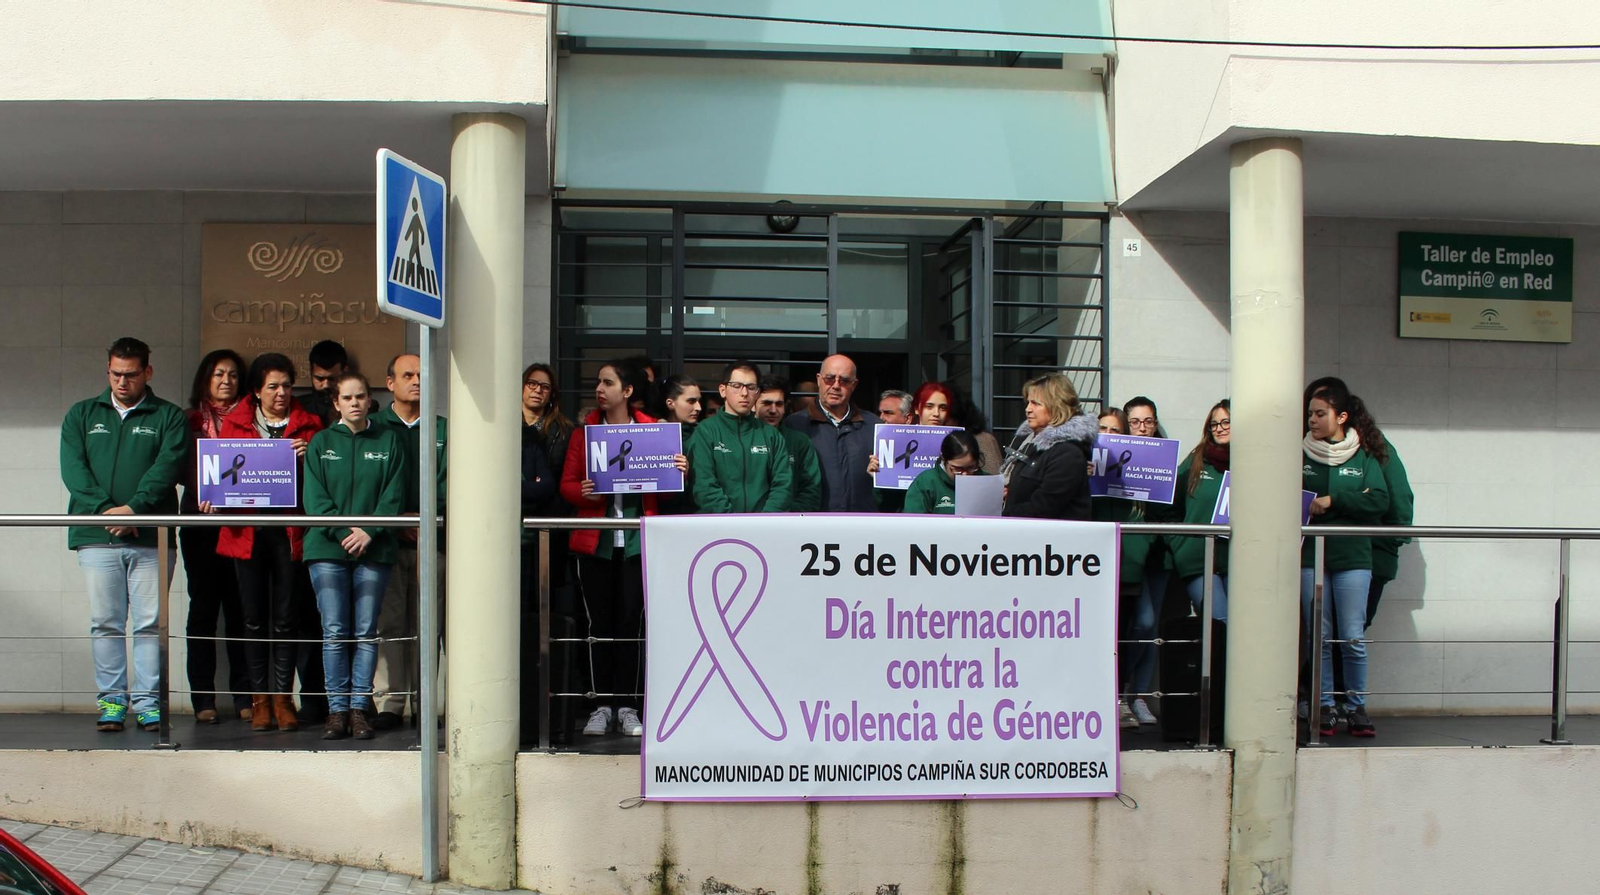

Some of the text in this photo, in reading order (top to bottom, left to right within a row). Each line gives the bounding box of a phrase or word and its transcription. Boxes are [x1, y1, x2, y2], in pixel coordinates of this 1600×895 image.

[1126, 243, 1138, 251] 45
[1421, 245, 1554, 269] Taller de Empleo
[1421, 269, 1553, 290] Campiñ@ en Red
[211, 293, 387, 332] campiñasu
[590, 441, 608, 473] N
[879, 439, 894, 469] N
[1092, 448, 1108, 477] N
[202, 454, 219, 486] N
[1141, 467, 1173, 475] VIOLENCIA
[800, 543, 1101, 577] 25 de Noviembre
[825, 598, 1080, 639] Día Internacional
[887, 647, 1019, 689] contra la
[800, 698, 1102, 742] Violencia de Género
[655, 760, 1109, 783] MANCOMUNIDAD DE MUNICIPIOS CAMPIÑA SUR CORDOBESA
